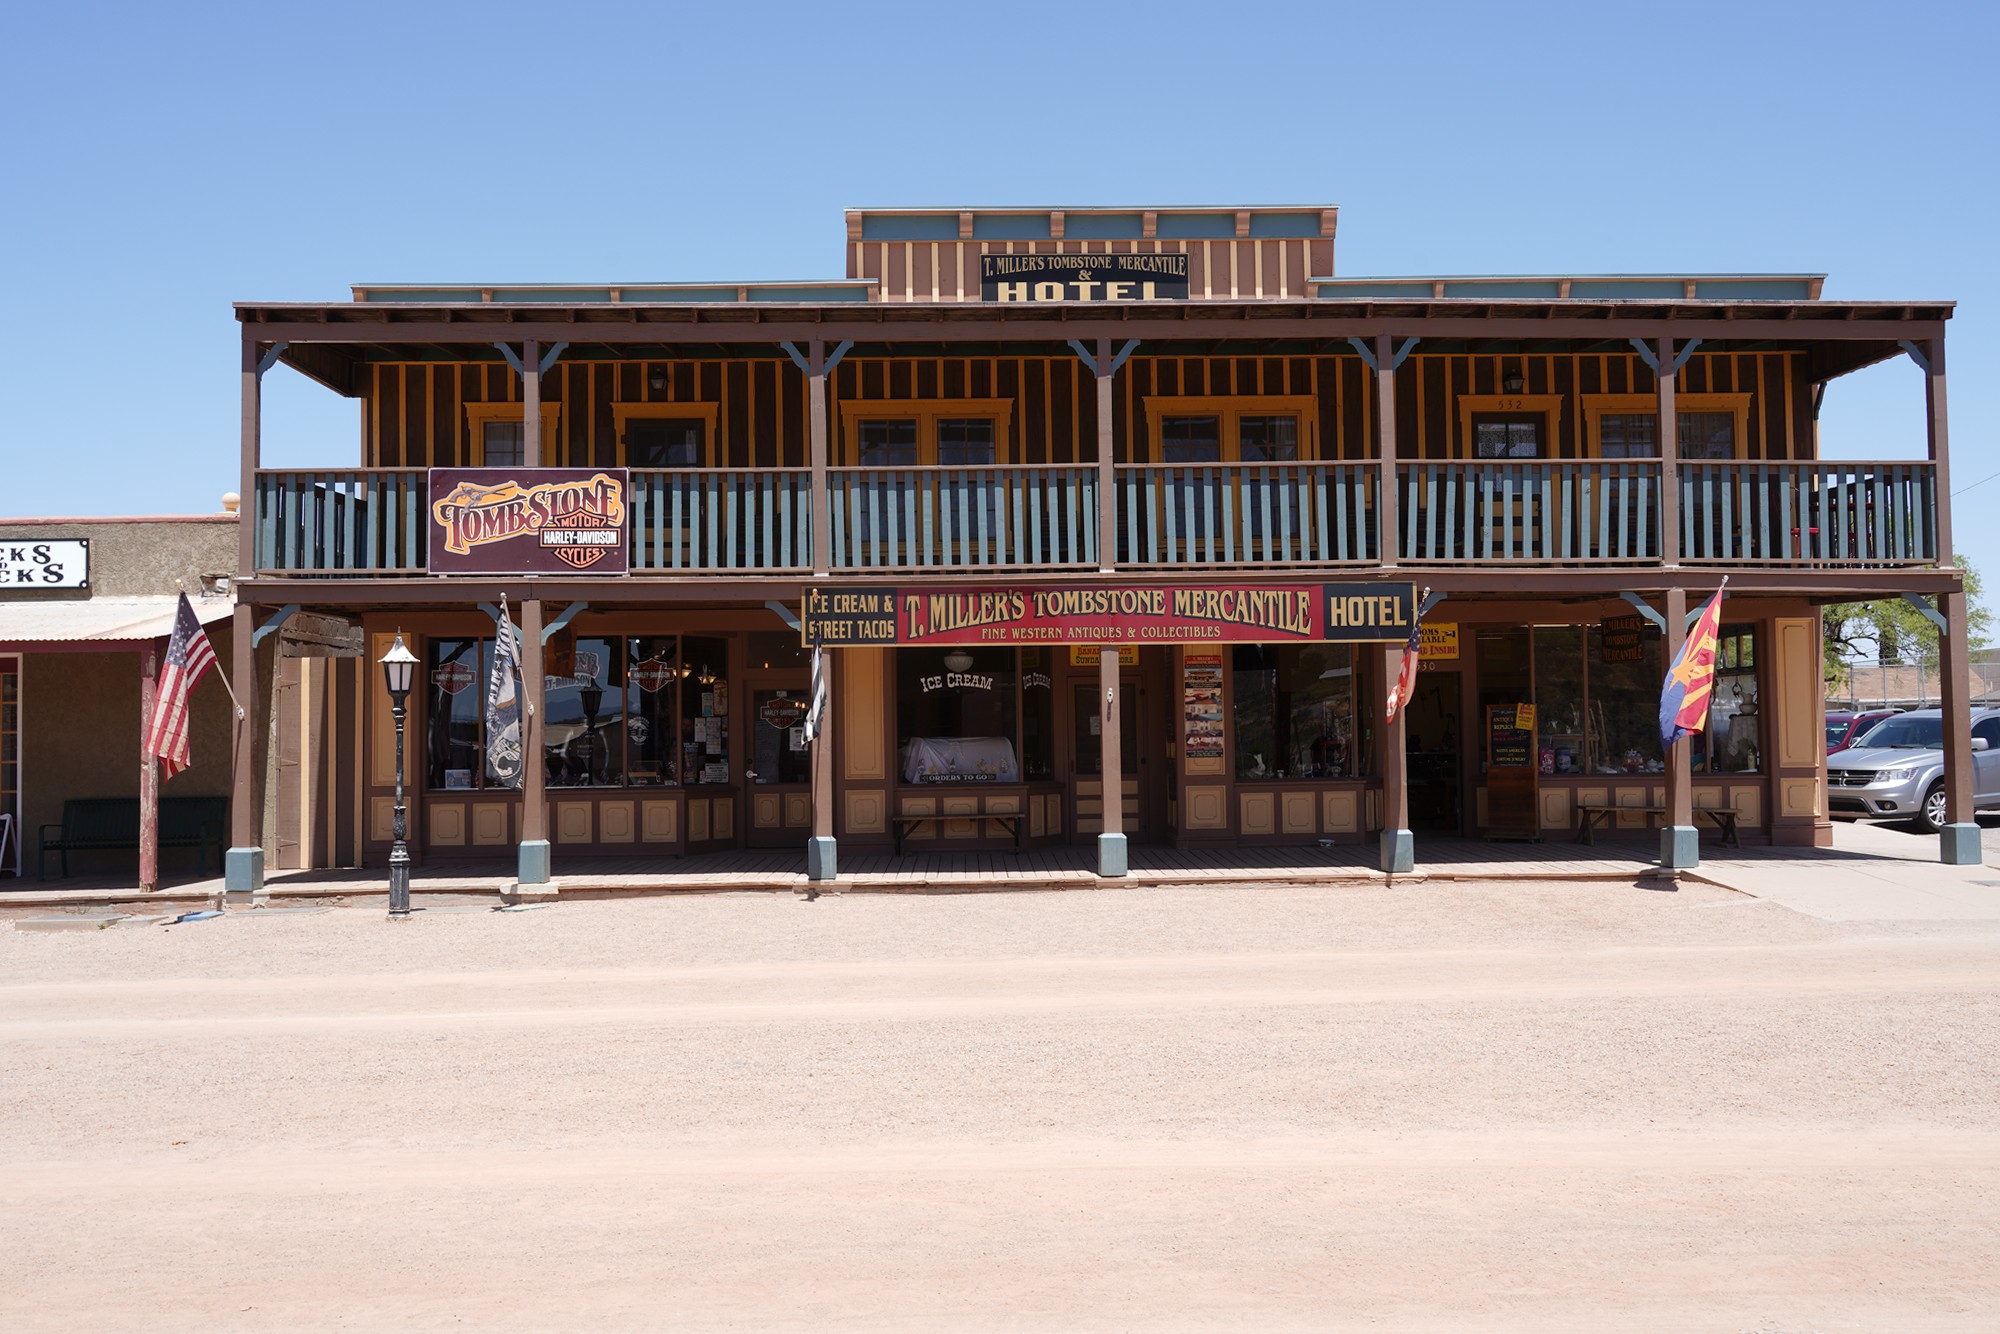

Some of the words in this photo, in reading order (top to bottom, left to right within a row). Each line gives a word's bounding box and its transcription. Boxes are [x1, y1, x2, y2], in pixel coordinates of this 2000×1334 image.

[984, 257, 993, 277] T.
[996, 256, 1045, 275] MILLER'S
[1047, 256, 1112, 270] TOMBSTONE
[1118, 256, 1186, 276] MERCANTILE
[1078, 269, 1092, 281] &
[997, 281, 1174, 302] HOTEL
[1498, 400, 1522, 410] 532
[561, 513, 600, 528] MOTOR
[543, 530, 617, 545] HARLEY-DAVIDSON
[561, 548, 600, 566] CYCLES
[834, 594, 878, 613] CREAM
[884, 595, 894, 613] &
[906, 594, 925, 639] T.
[929, 589, 1026, 633] MILLER'S
[1033, 590, 1167, 617] TOMBSTONE
[1174, 590, 1312, 635] MERCANTILE
[1330, 596, 1407, 627] HOTEL
[809, 620, 853, 639] STREET
[857, 620, 895, 639] TACOS
[981, 628, 1007, 640] FINE
[1011, 627, 1063, 640] WESTERN
[1067, 626, 1122, 640] ANTIQUES
[1127, 627, 1136, 638] &
[1141, 626, 1221, 638] COLLECTIBLES
[1420, 628, 1439, 636] OMS
[1605, 633, 1638, 646] TOMBSTONE
[1077, 647, 1100, 655] BANA
[1430, 645, 1456, 656] INSIDE
[1602, 644, 1643, 661] MERCANTILE
[1075, 656, 1100, 664] SUNDA
[1119, 656, 1134, 664] ORE
[633, 671, 670, 679] HARLEY-DAVIDSON
[920, 675, 943, 693] ICE
[946, 672, 993, 691] CREAM
[1022, 675, 1032, 690] ICE
[1033, 672, 1051, 689] CREAM
[928, 774, 960, 782] ORDERS
